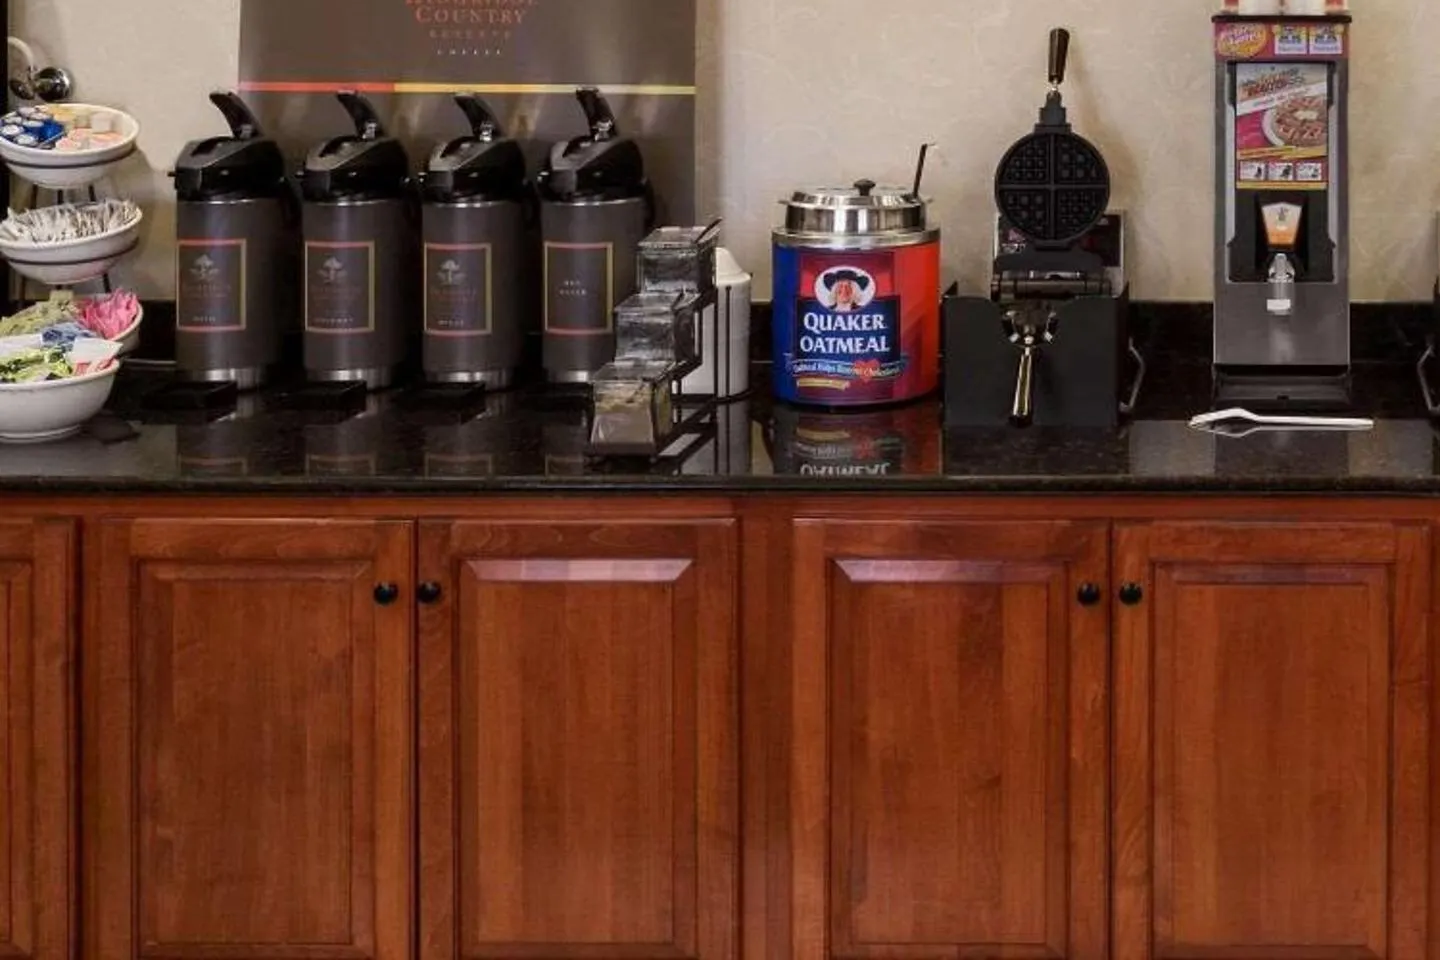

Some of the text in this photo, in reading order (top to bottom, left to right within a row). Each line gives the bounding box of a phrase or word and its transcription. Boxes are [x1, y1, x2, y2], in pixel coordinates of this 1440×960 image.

[415, 5, 527, 24] COUNTRY
[803, 312, 885, 335] QUAKER
[799, 335, 891, 354] OATMEAL
